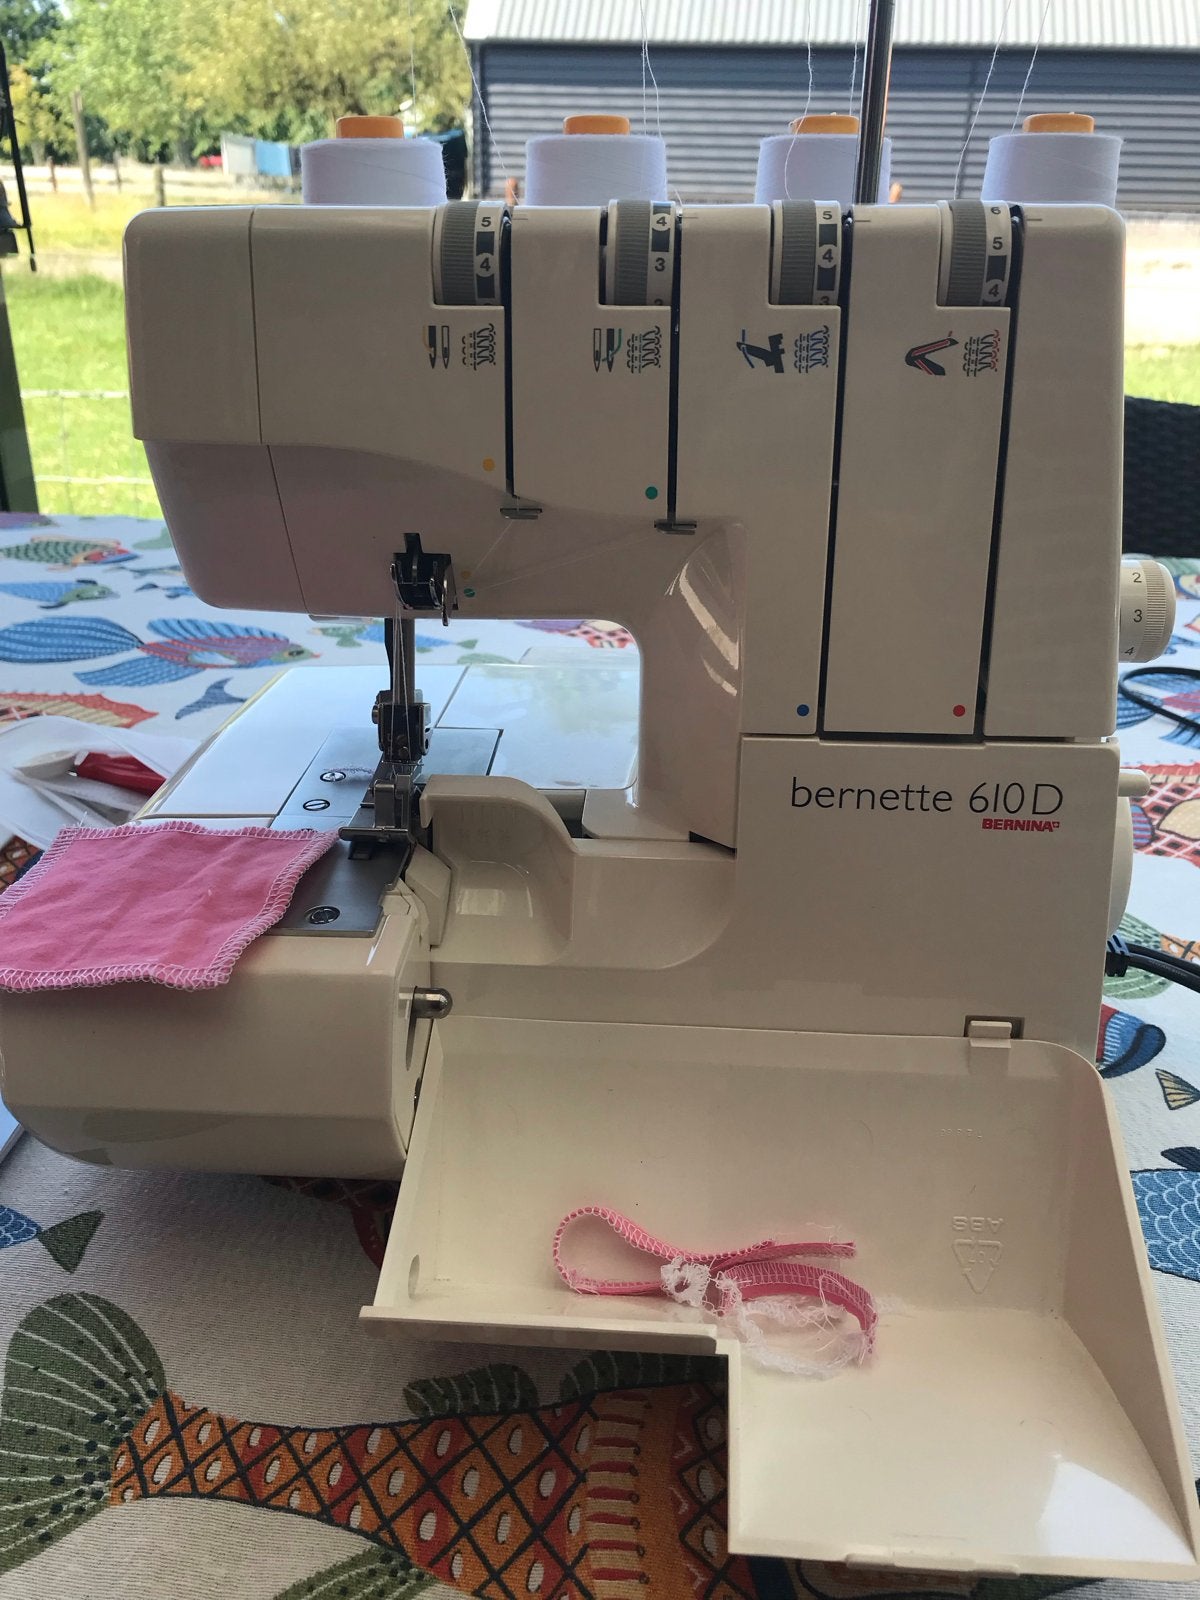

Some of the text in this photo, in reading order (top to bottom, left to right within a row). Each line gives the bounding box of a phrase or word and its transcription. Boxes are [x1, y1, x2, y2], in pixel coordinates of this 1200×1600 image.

[822, 210, 833, 220] 5
[990, 206, 1001, 215] 6
[481, 216, 492, 228] 5
[656, 216, 668, 227] 4
[992, 236, 1003, 250] 5
[822, 248, 834, 263] 4
[479, 257, 491, 272] 4
[654, 257, 666, 272] 3
[988, 283, 1000, 298] 4
[1132, 572, 1142, 583] 2
[1133, 609, 1143, 623] 3
[1124, 646, 1135, 656] 4
[791, 776, 953, 813] bernette
[981, 817, 1055, 833] BERNINA
